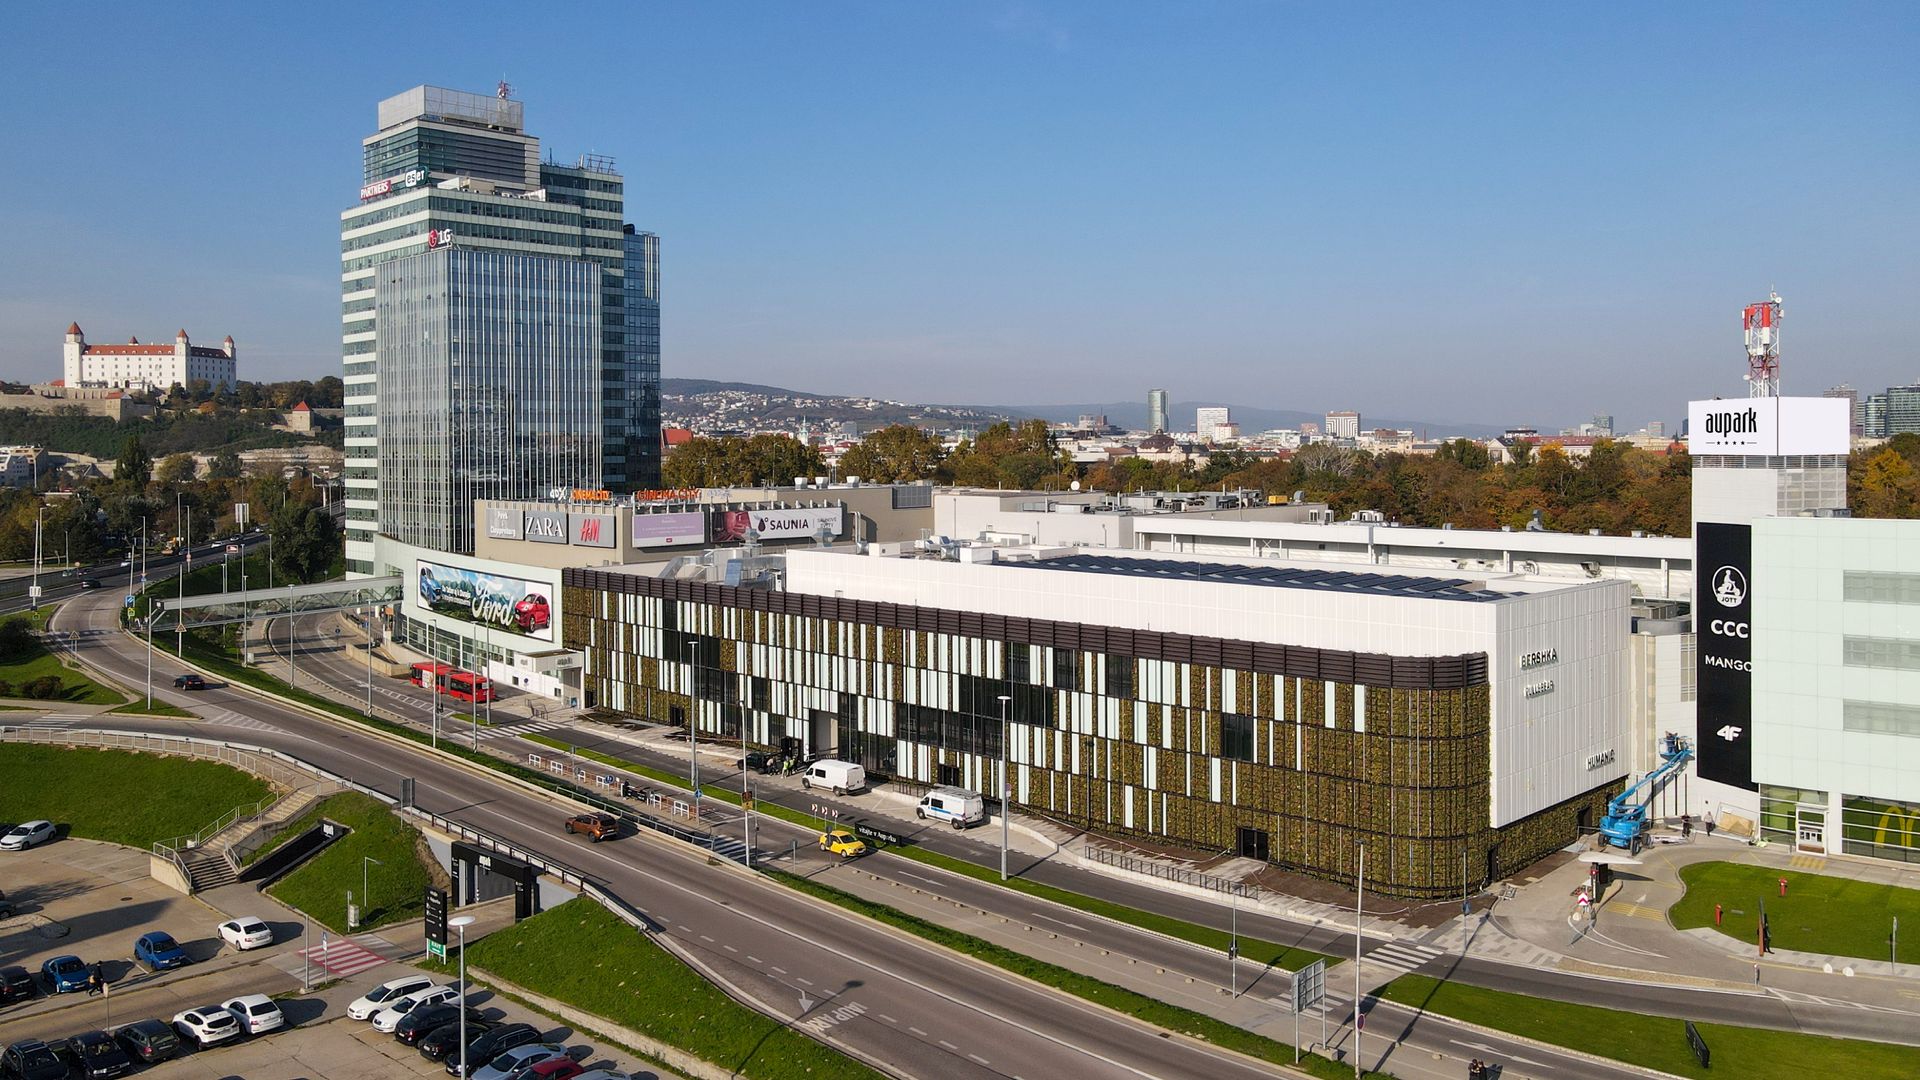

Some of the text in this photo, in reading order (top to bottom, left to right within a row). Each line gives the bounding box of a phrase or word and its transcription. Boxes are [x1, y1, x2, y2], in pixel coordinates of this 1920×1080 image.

[361, 182, 389, 198] PARTNERS
[438, 229, 453, 244] LG
[1706, 407, 1757, 438] aupark
[571, 489, 610, 501] CINEMA CITY
[637, 490, 676, 501] CINEMA
[678, 487, 701, 500] CITY
[525, 517, 564, 537] ZARA
[581, 519, 600, 542] H&M
[770, 519, 809, 530] SAUNIA
[472, 577, 514, 626] Ford
[1711, 619, 1749, 638] CCC
[1520, 648, 1558, 668] BERSHKA
[1717, 725, 1742, 742] 4F
